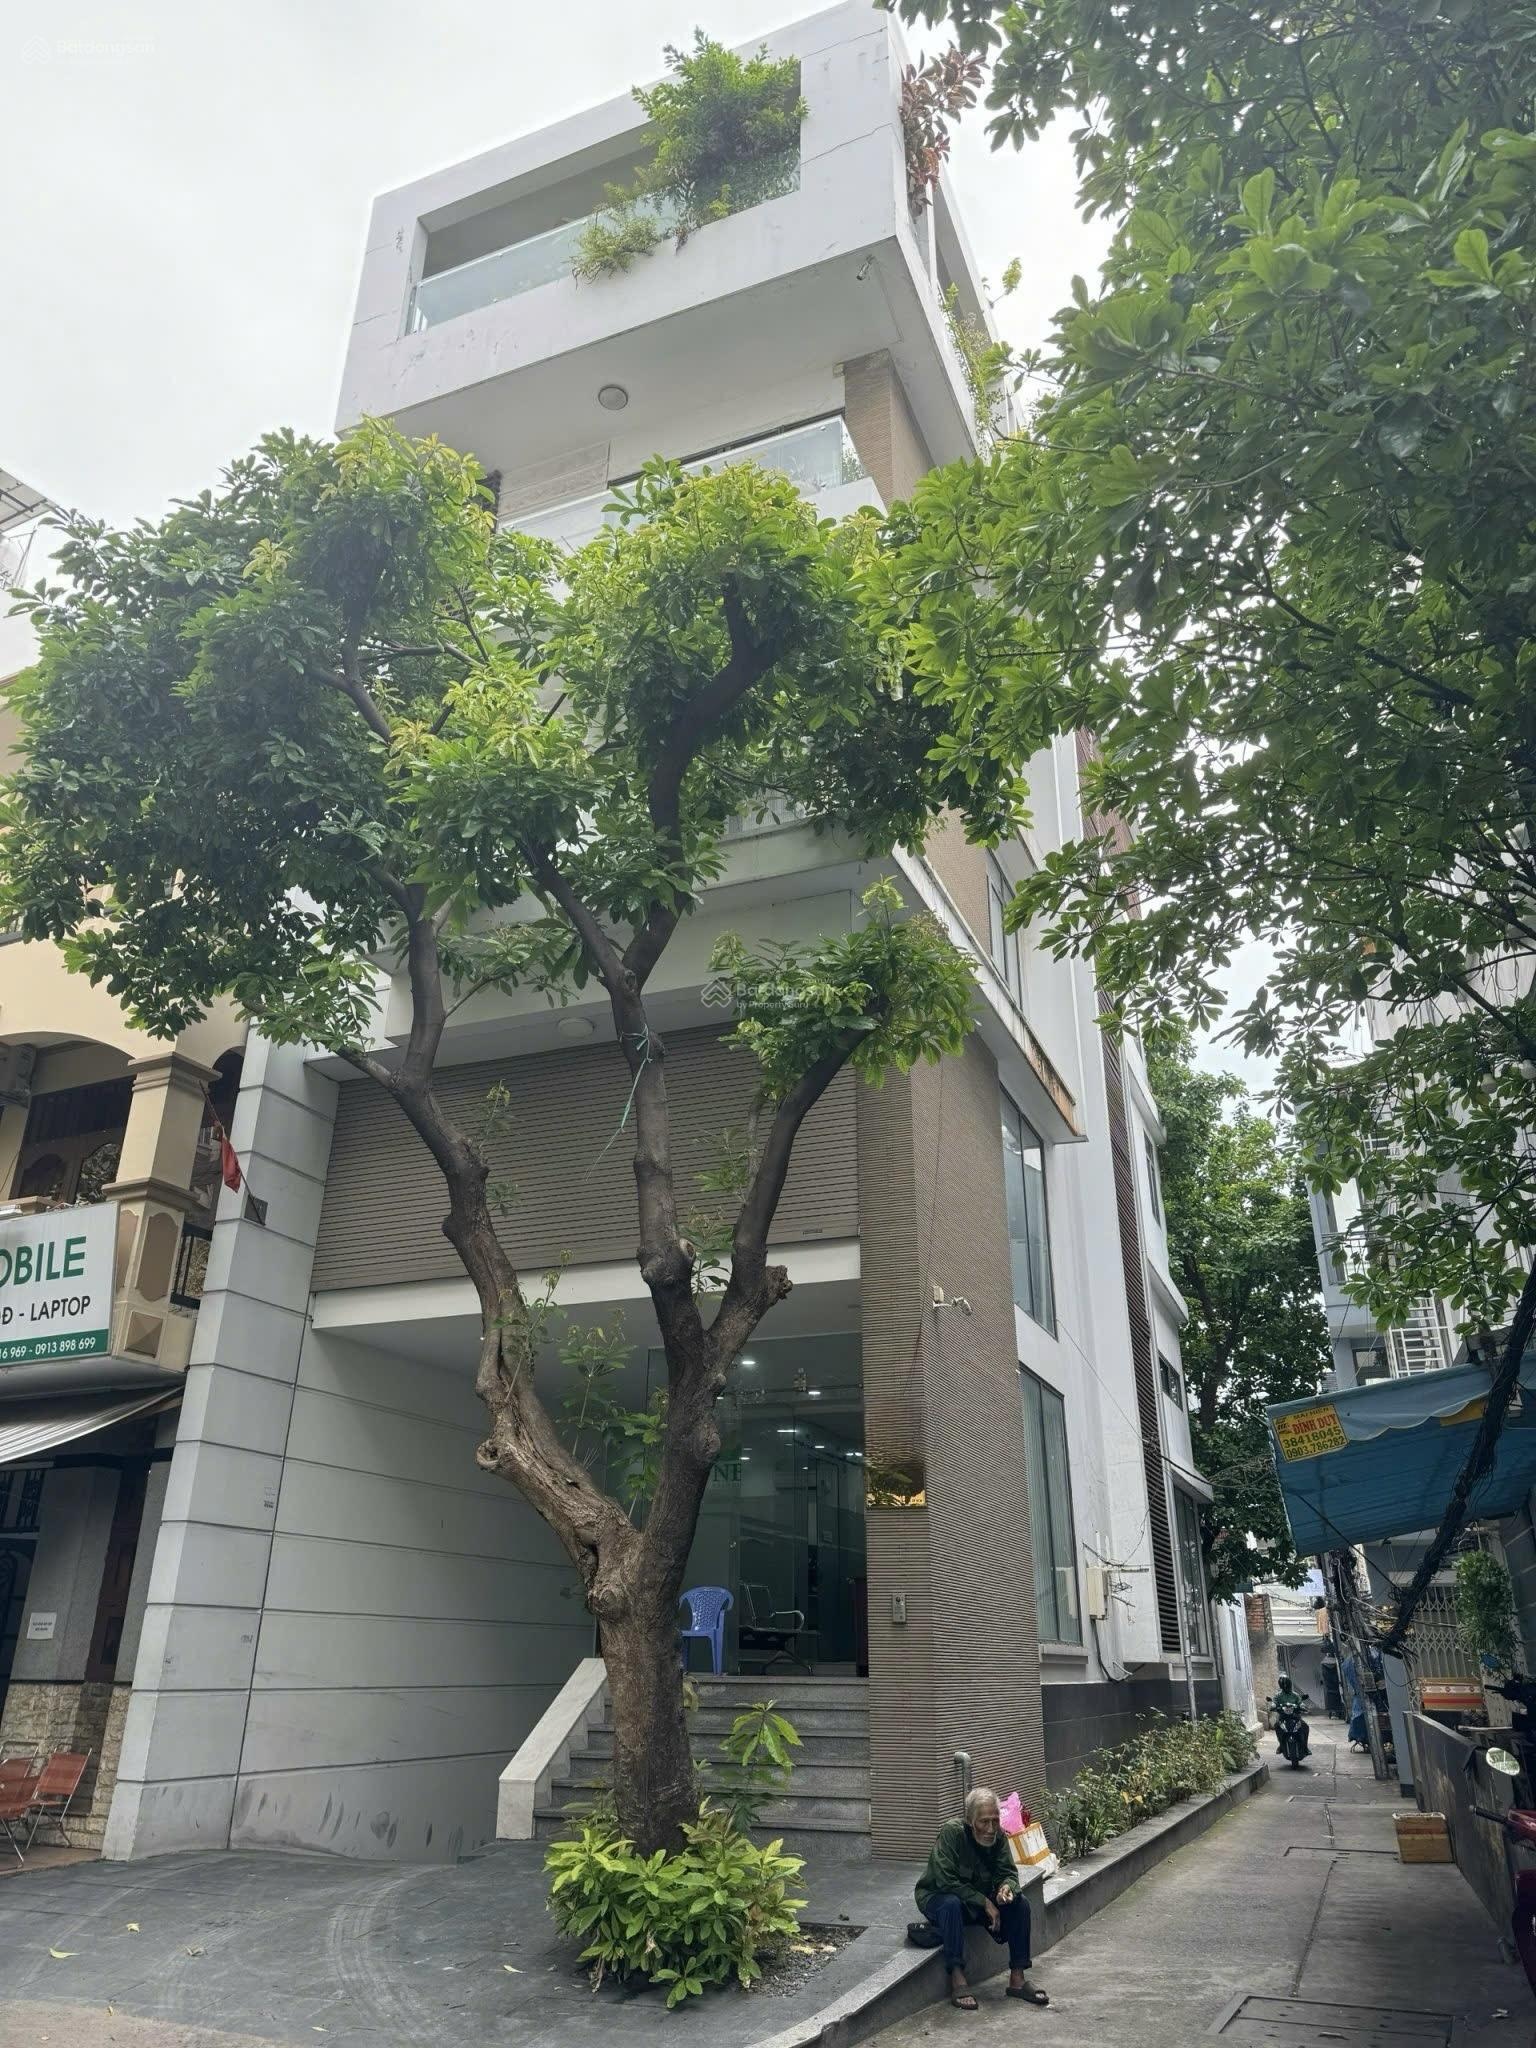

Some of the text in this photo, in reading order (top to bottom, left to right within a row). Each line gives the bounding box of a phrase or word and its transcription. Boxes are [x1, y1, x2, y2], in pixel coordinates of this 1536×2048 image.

[31, 1295, 91, 1321] LAPTOP
[10, 1345, 27, 1358] 969
[35, 1341, 57, 1355] 0913
[60, 1339, 77, 1352] 898
[78, 1337, 96, 1350] 699
[1284, 1426, 1341, 1449] 38418045
[1286, 1436, 1346, 1459] 0903.786282
